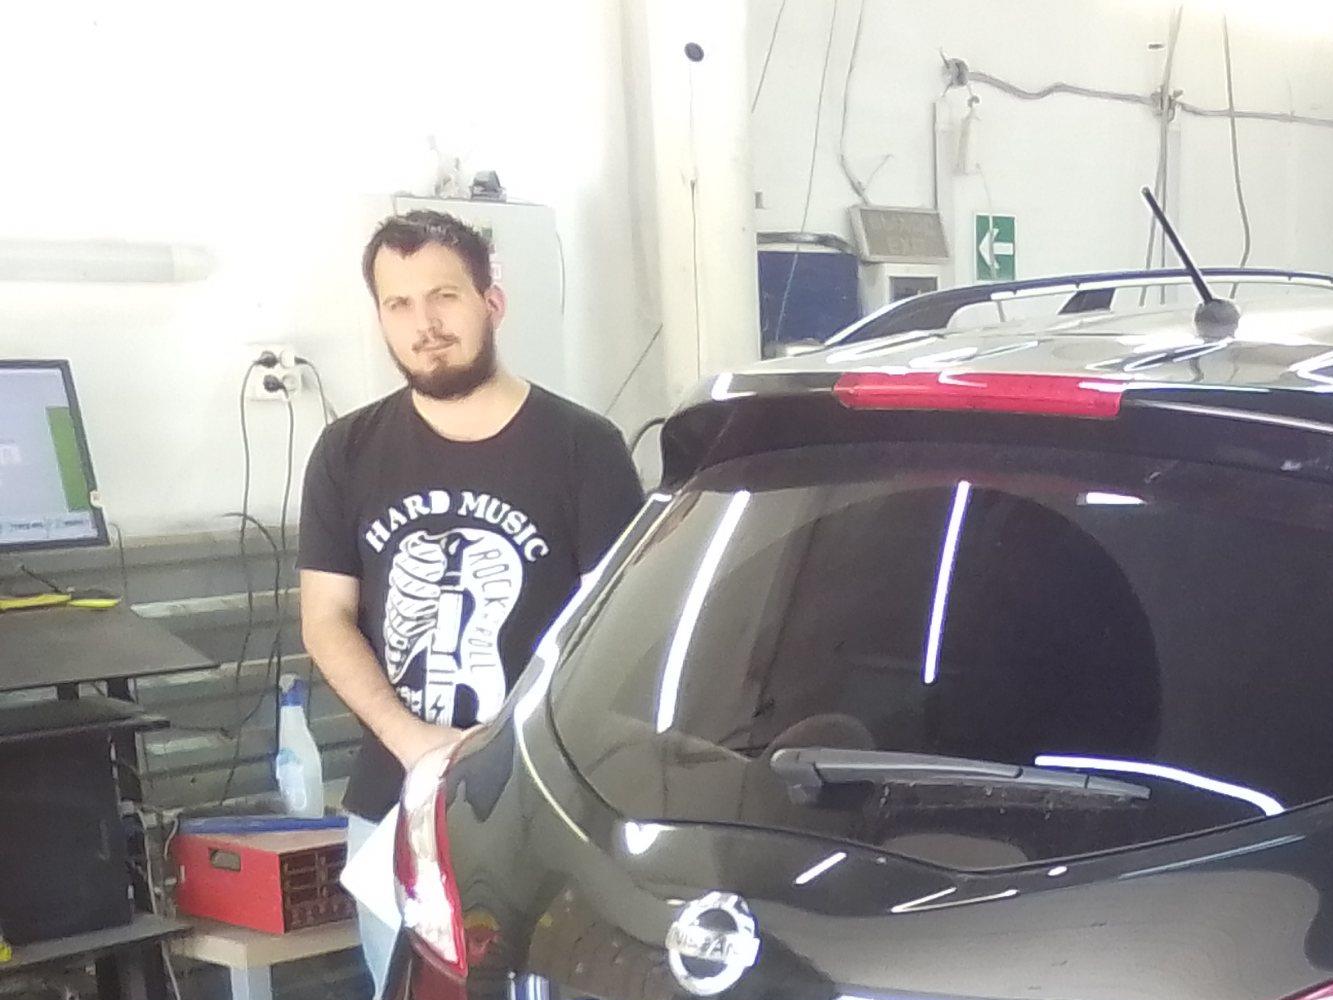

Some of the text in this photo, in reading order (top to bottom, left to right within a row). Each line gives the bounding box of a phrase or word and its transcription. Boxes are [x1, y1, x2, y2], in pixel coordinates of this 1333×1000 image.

[365, 490, 549, 562] HARD MUSIC
[468, 548, 512, 609] ROCK
